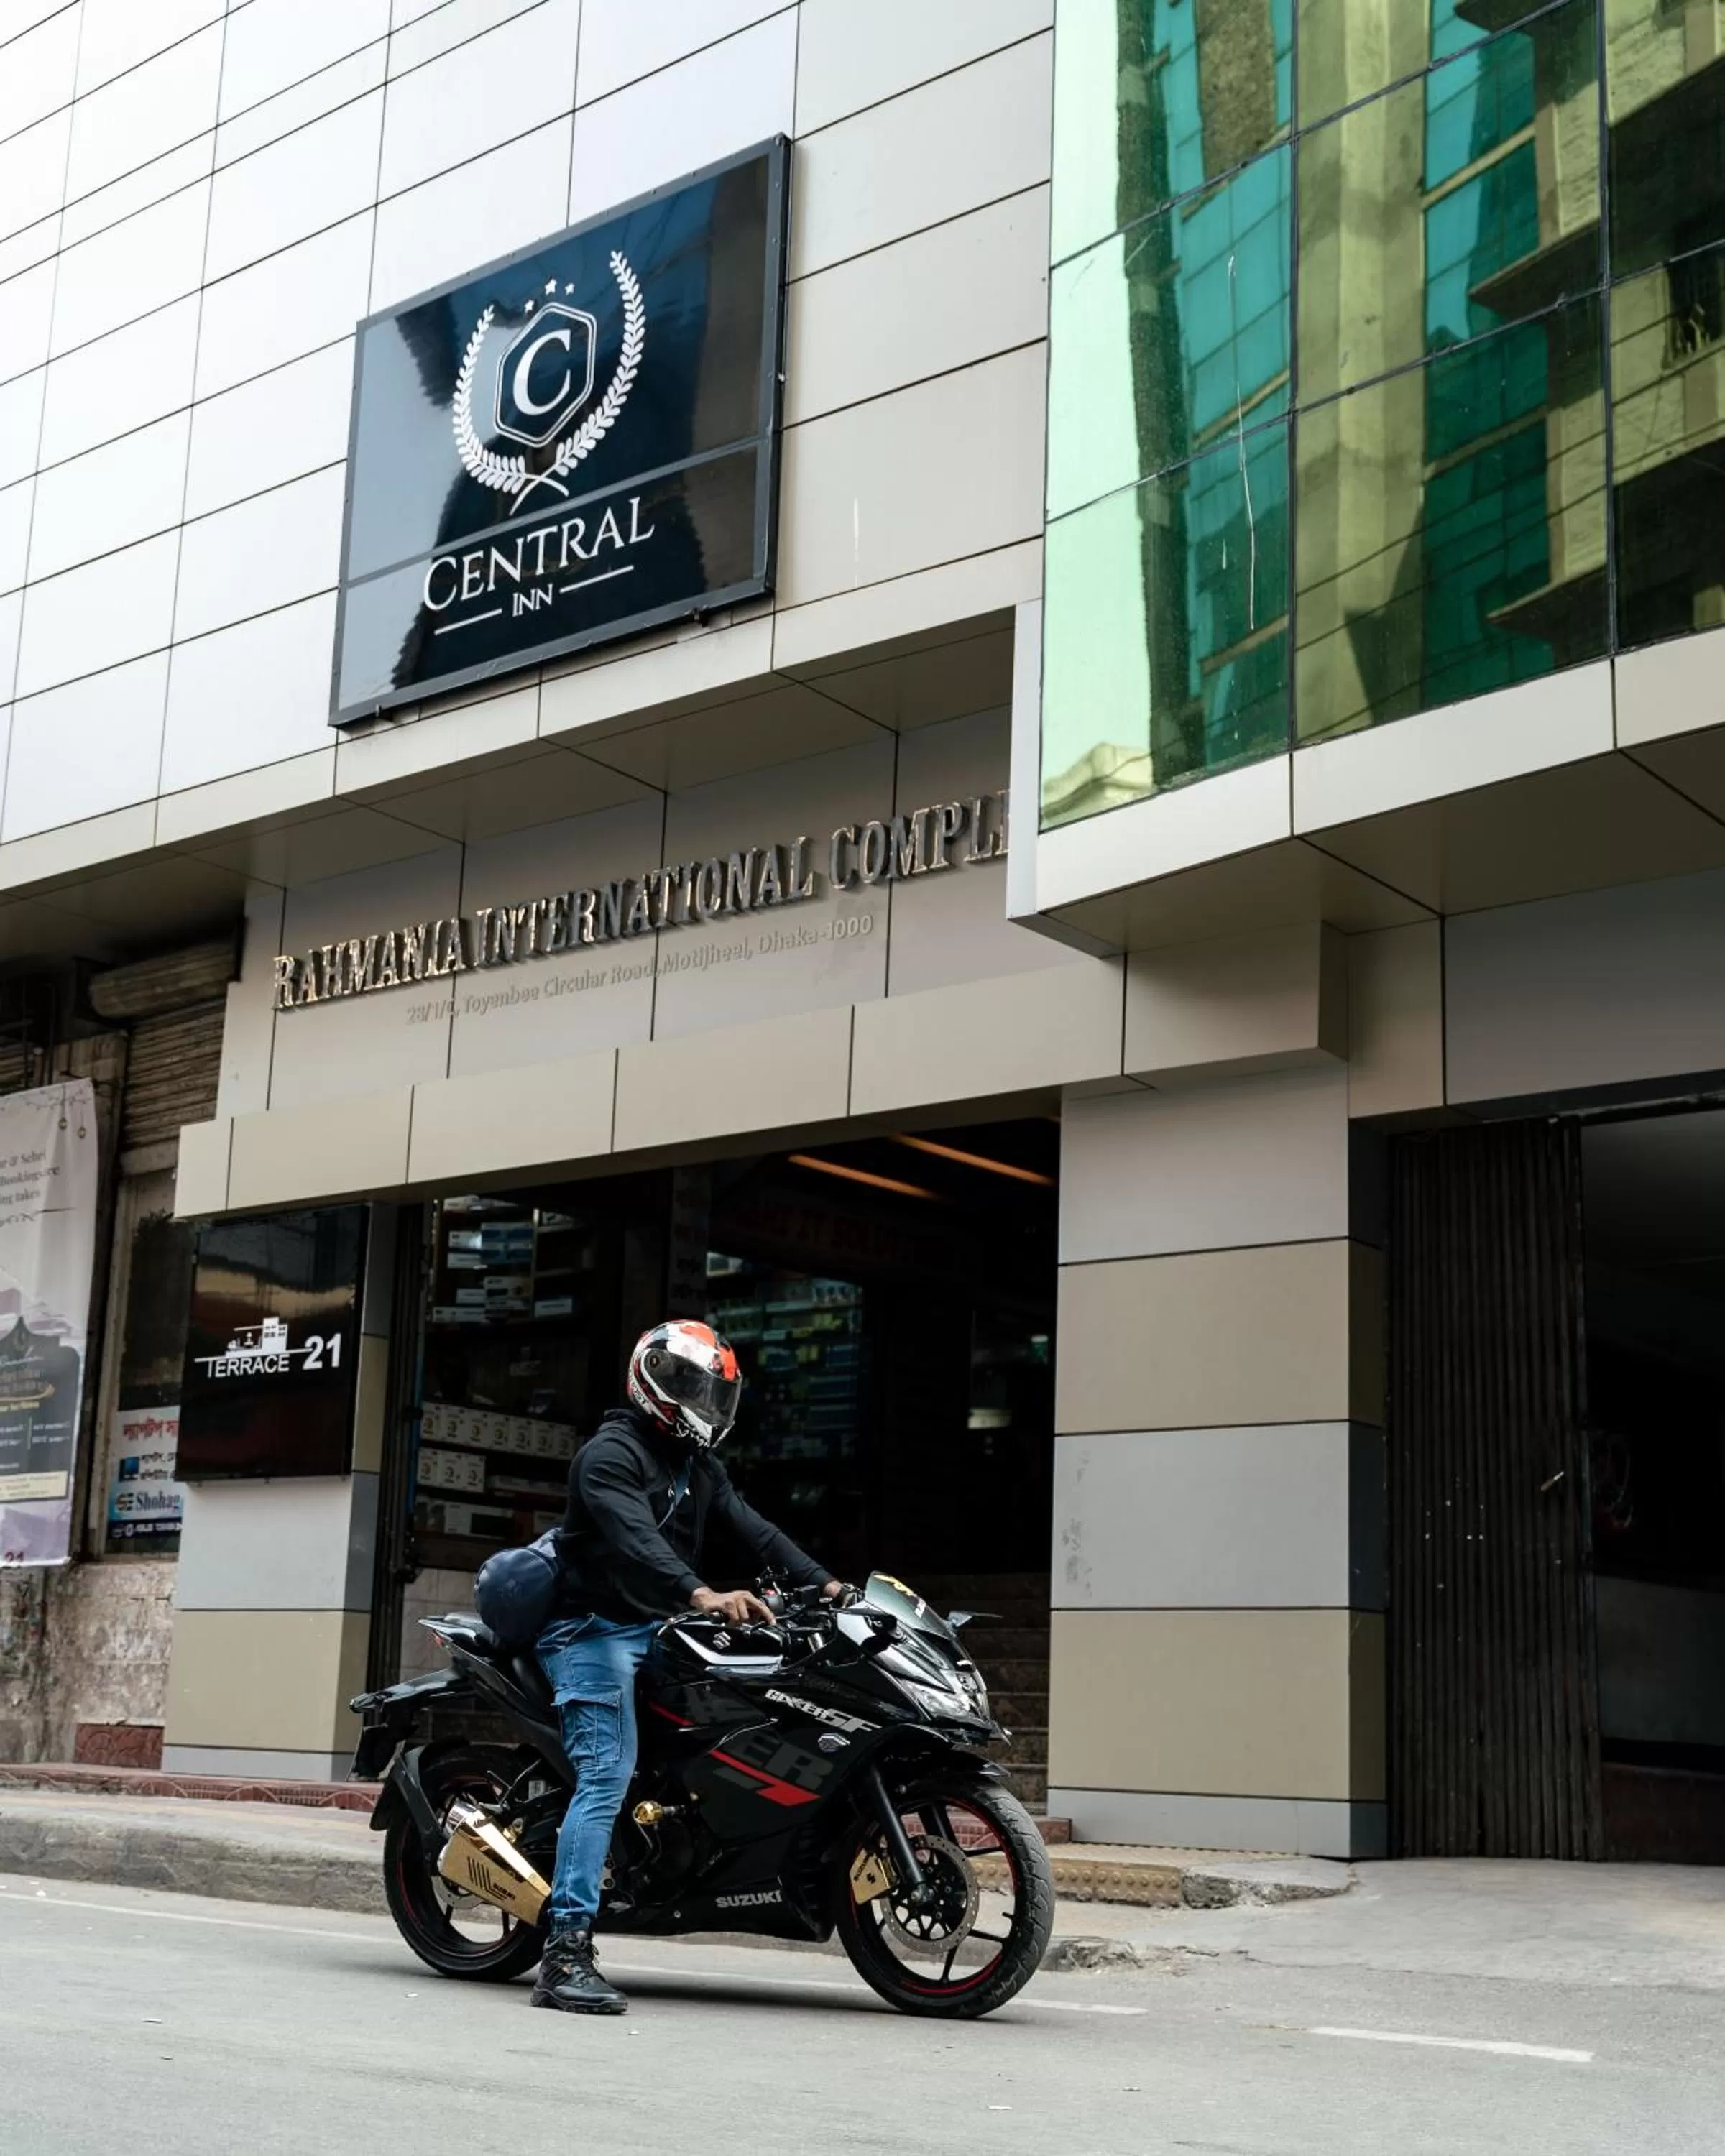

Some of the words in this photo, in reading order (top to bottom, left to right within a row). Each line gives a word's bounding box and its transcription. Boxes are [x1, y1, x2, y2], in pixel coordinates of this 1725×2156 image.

[512, 328, 571, 416] C
[423, 496, 654, 612] CENTRAL
[512, 584, 553, 617] INN
[272, 916, 466, 1010] RAHMANIA
[474, 834, 815, 968] INTERNATIONAL
[543, 968, 608, 998] Circular
[204, 1354, 290, 1378] TERRACE
[303, 1332, 341, 1370] 21
[715, 1889, 783, 1909] SUZUKI
